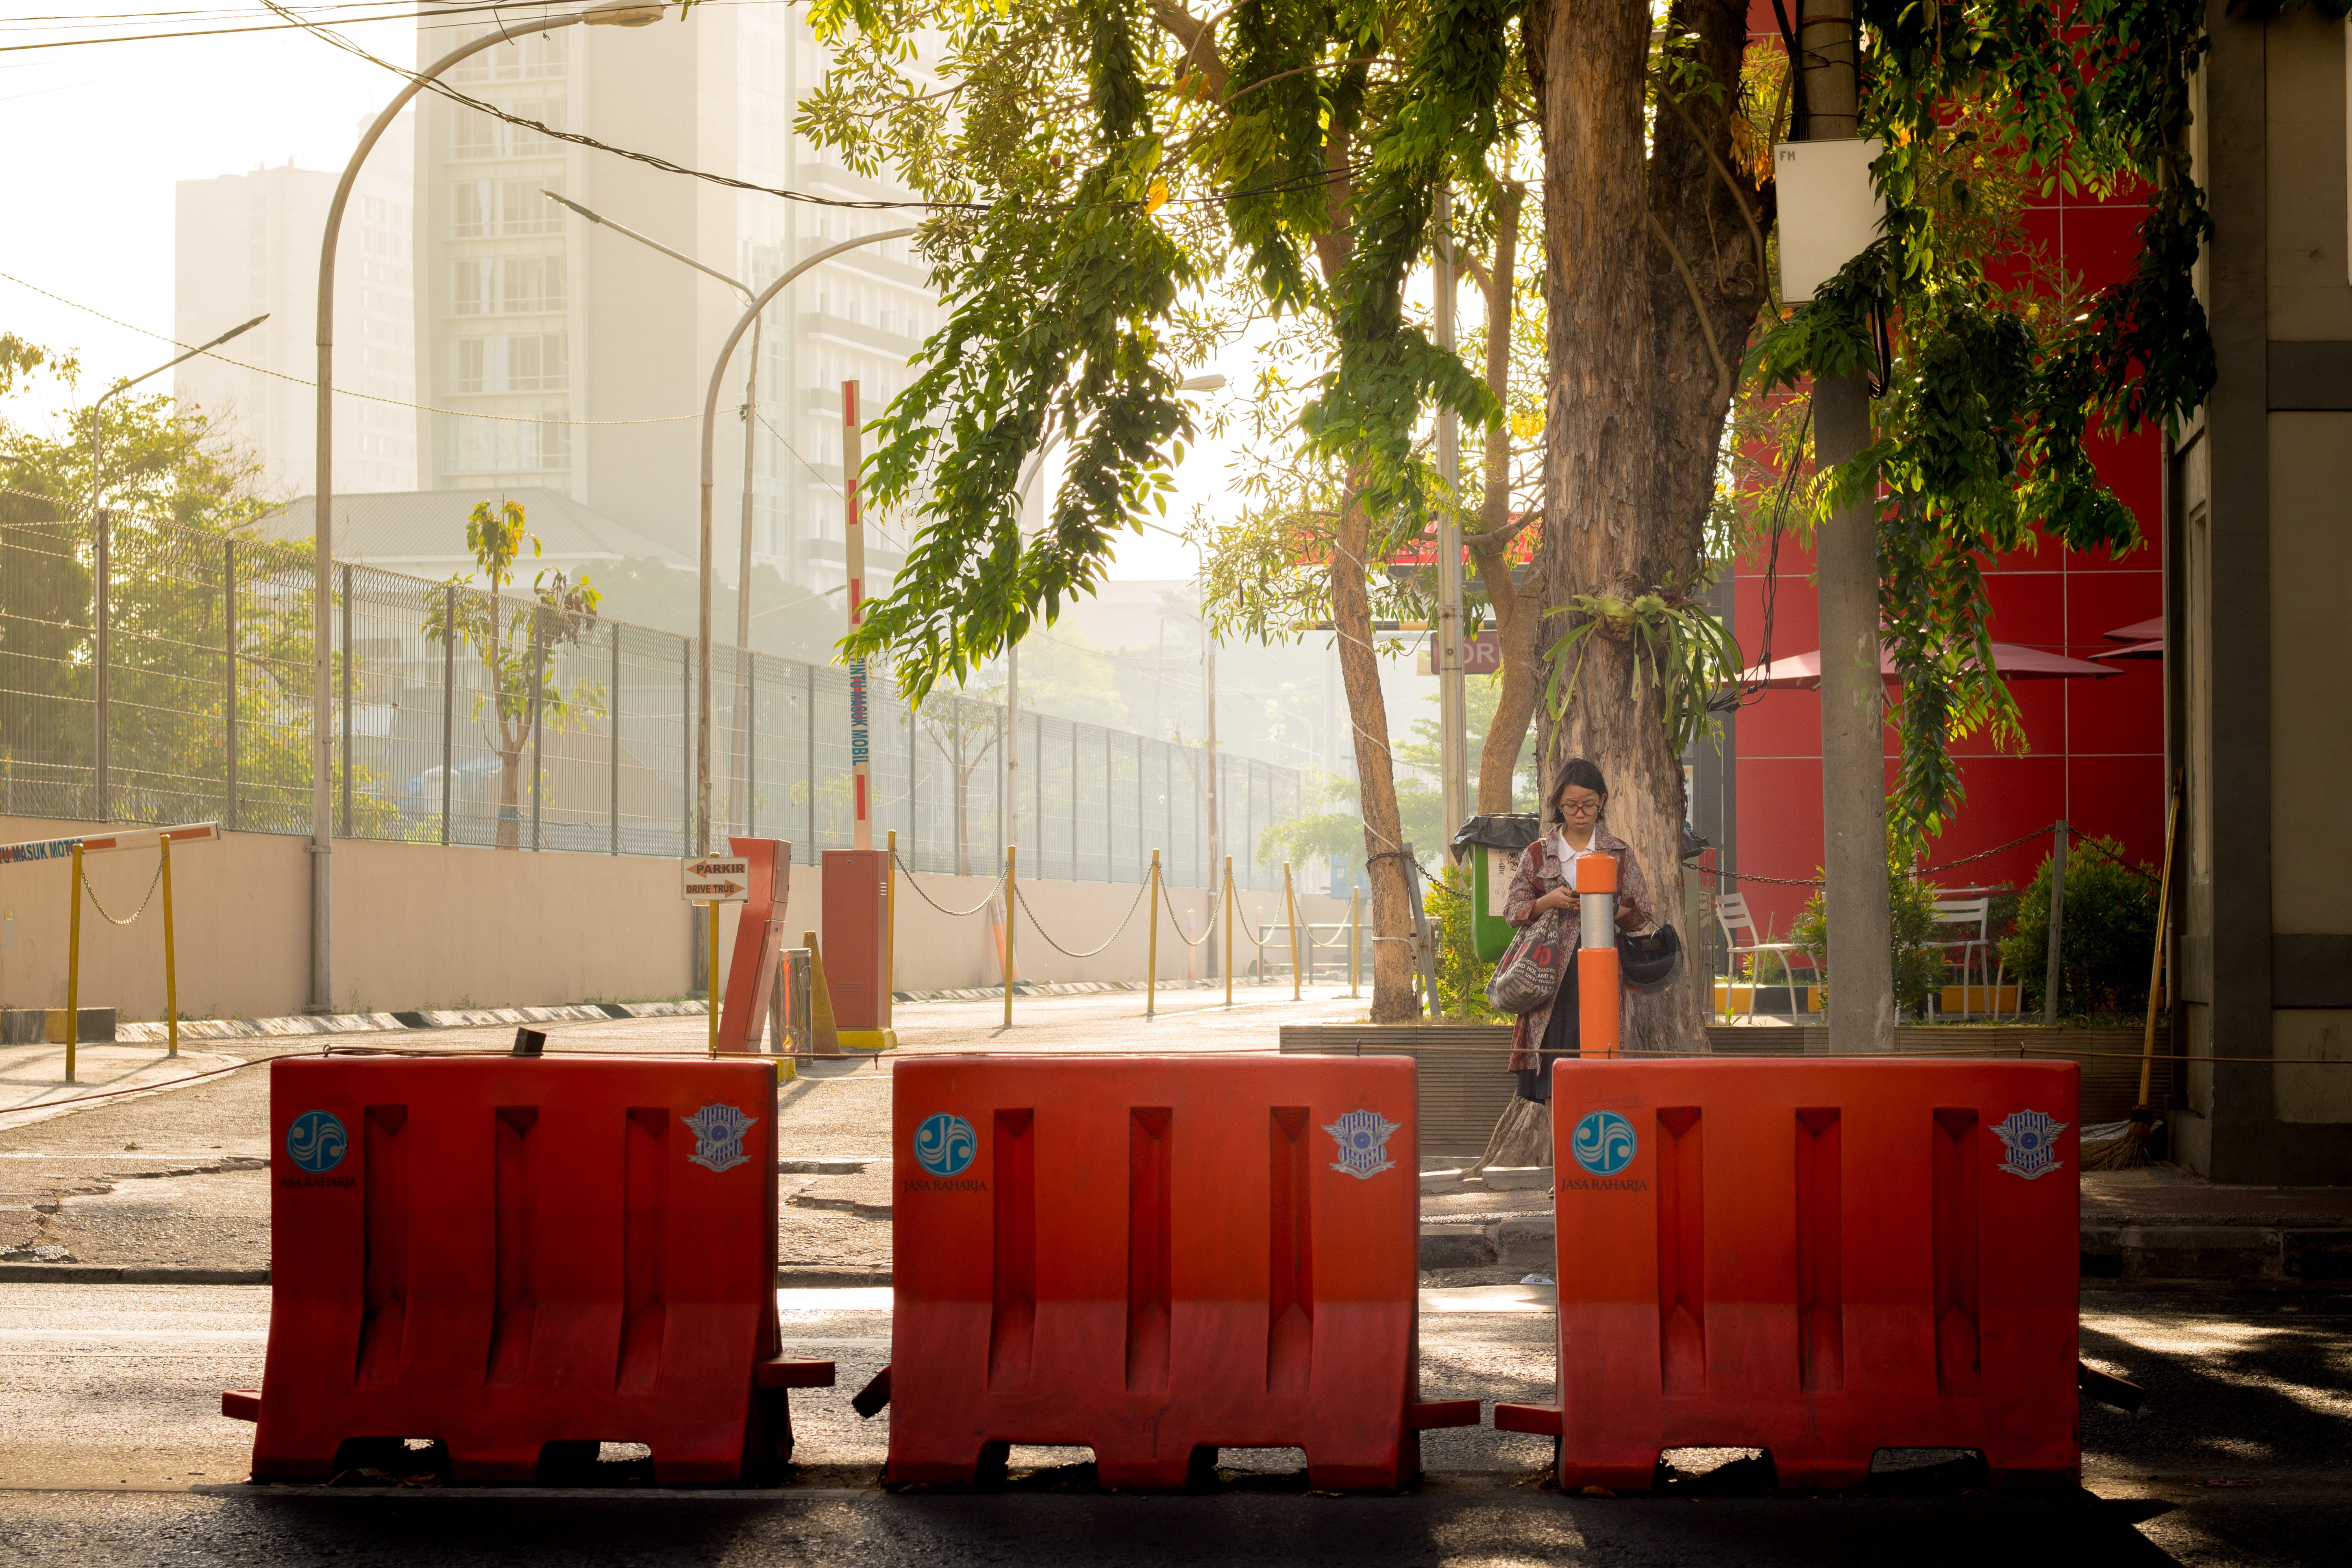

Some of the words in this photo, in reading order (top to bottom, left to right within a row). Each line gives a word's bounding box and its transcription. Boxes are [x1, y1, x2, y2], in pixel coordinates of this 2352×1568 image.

[1780, 151, 1795, 161] FM
[849, 658, 866, 688] PINTU
[850, 691, 868, 727] MASUK
[12, 842, 48, 862] MASUK
[697, 864, 744, 873] PARKIR
[687, 885, 711, 893] DRIVE
[713, 885, 734, 893] TRUE
[305, 1177, 358, 1190] RAHARJA
[903, 1180, 931, 1194] JASA
[933, 1180, 988, 1193] RAHARJA
[1561, 1178, 1589, 1192] JASA
[1591, 1178, 1647, 1193] RAHARJA
